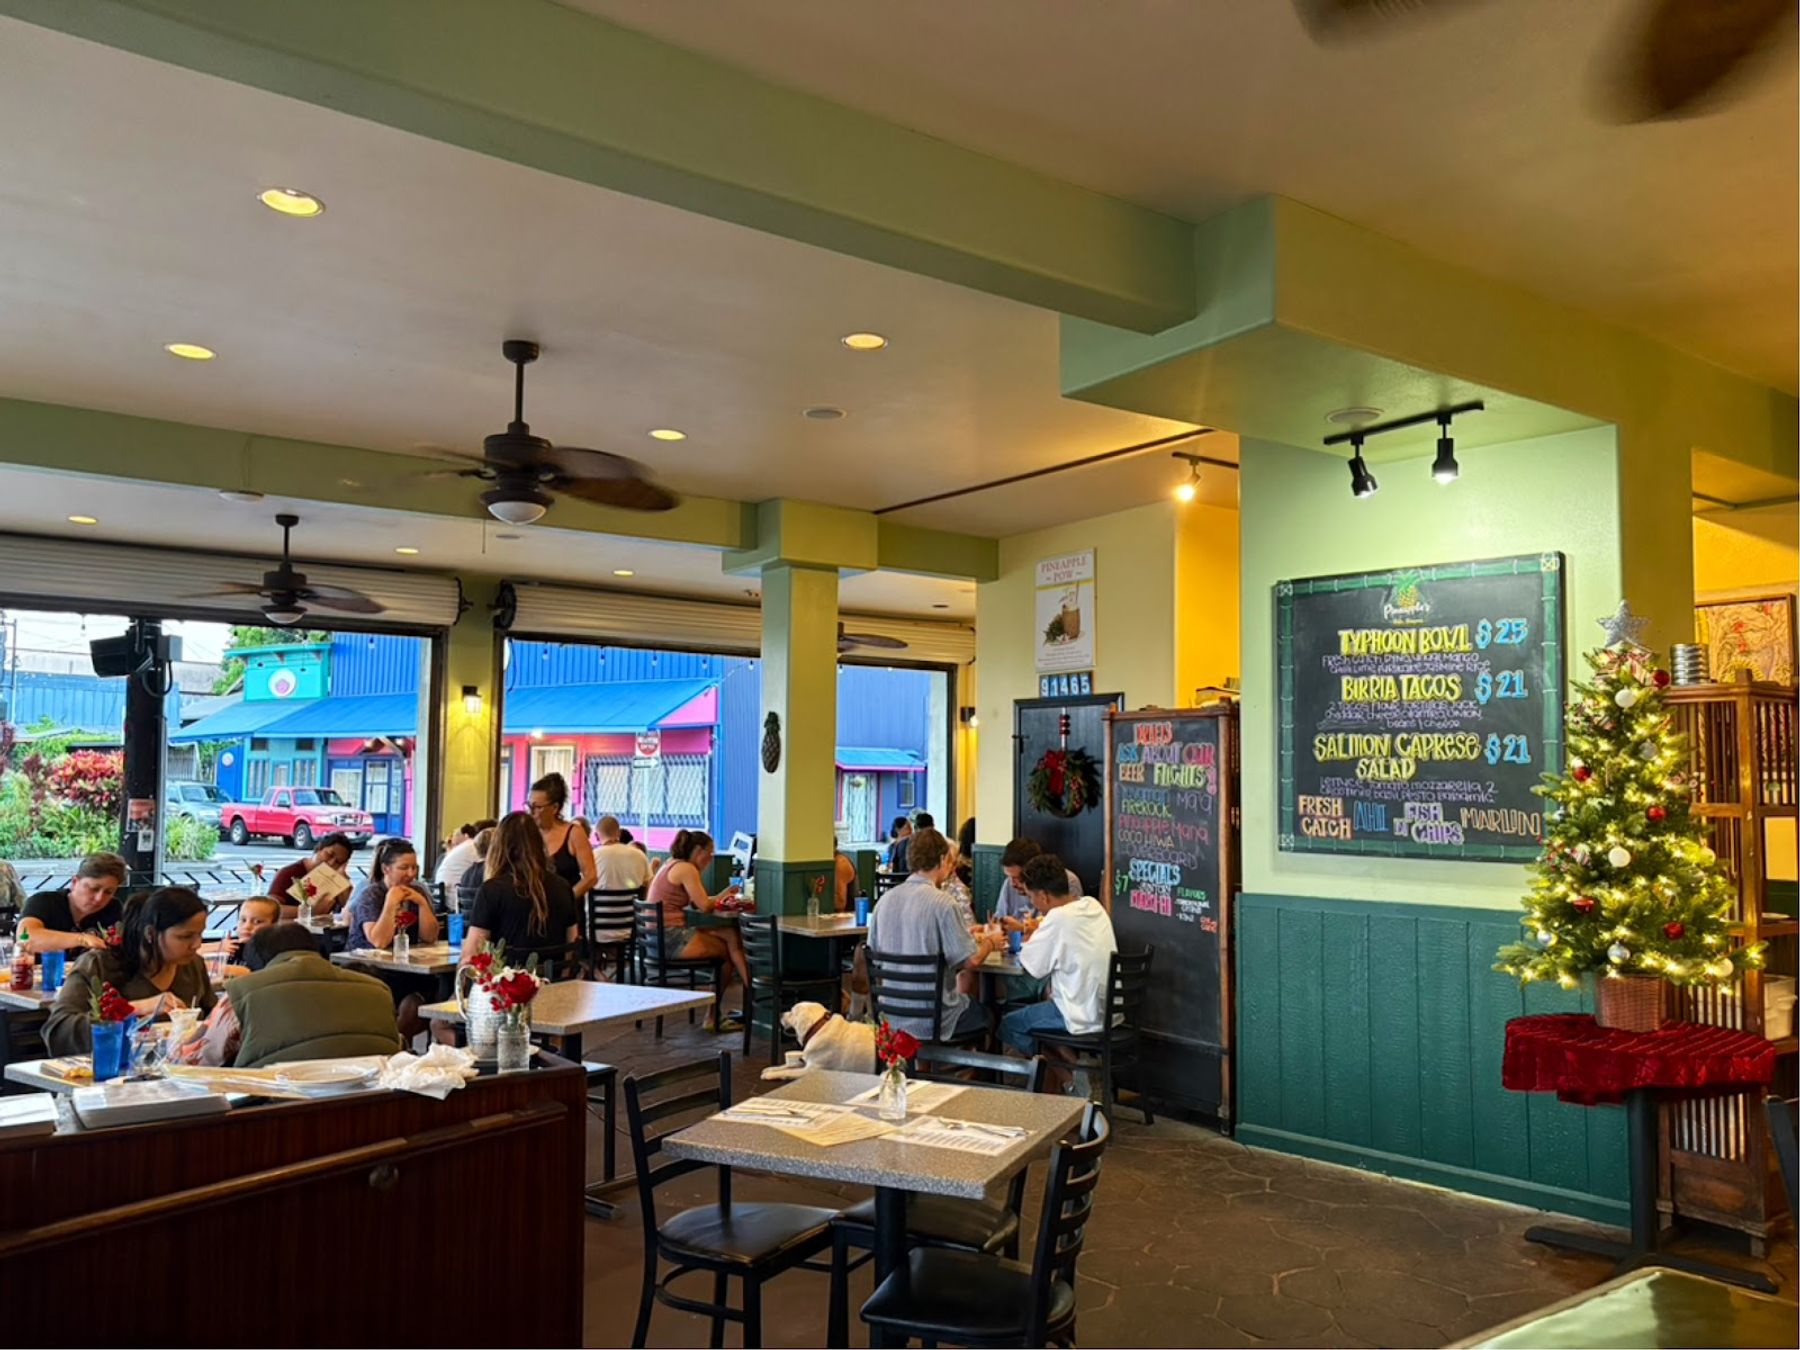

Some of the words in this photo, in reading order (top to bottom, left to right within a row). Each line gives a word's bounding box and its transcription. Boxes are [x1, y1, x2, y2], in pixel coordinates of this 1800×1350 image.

[1040, 556, 1088, 574] PINEAPPLE
[1054, 570, 1073, 583] POW
[1338, 629, 1416, 656] TYPHOON
[1418, 624, 1473, 655] BOWL
[1341, 675, 1400, 701] BIRRIA
[1400, 674, 1463, 701] TACOS
[1475, 670, 1528, 704] $21
[1141, 742, 1183, 764] ABOUT
[1313, 733, 1393, 762] SALMON
[1484, 733, 1532, 764] $21
[1355, 758, 1416, 781] SALAD
[1298, 795, 1344, 817] FRESH
[1404, 802, 1443, 822] FISH
[1301, 817, 1353, 841] CATCH
